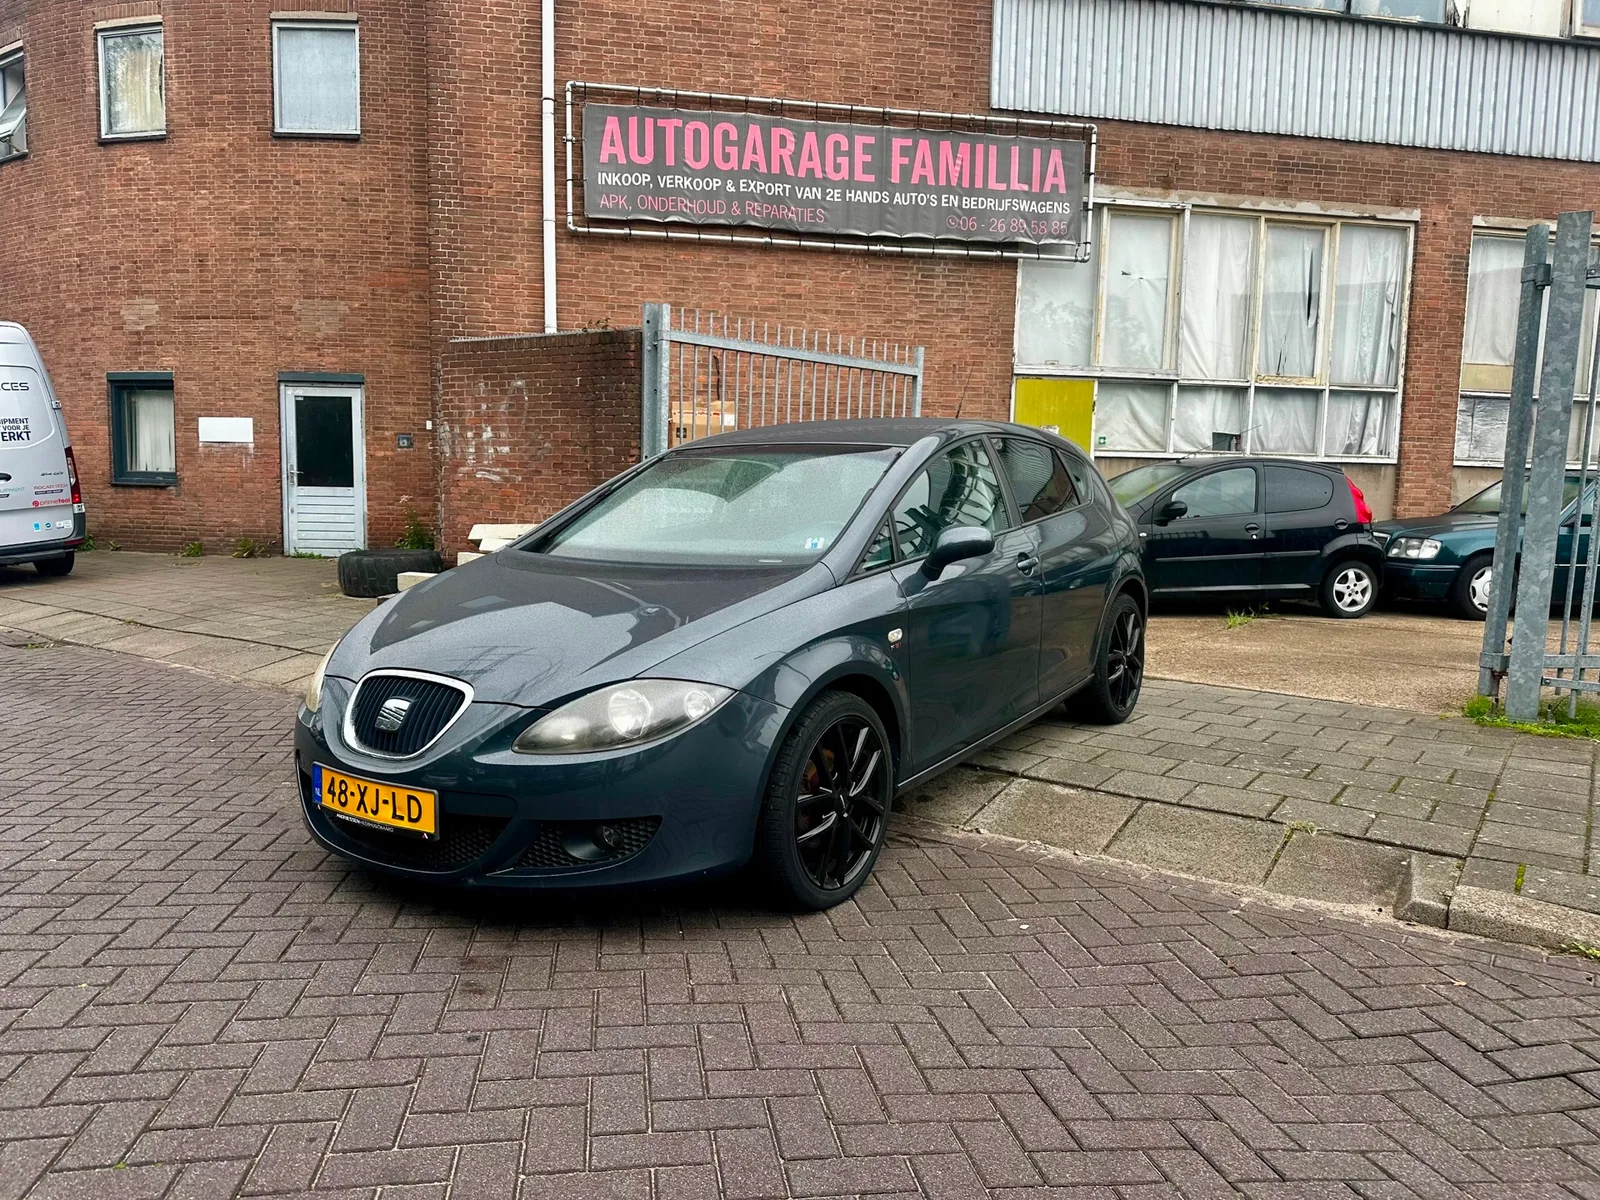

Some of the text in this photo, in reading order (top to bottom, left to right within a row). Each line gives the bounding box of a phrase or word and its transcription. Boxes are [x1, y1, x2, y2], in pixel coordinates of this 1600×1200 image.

[600, 116, 1066, 194] AUTOGARAGE FAMILLIA
[598, 172, 1070, 215] INKOOP, VERKOOP & EXPORT VAN 2E HANDS AUTO'S EN BEDRIJFSWAGENS
[600, 194, 825, 223] APK, ONDERHOUD & REPARATIES
[960, 216, 977, 231] 06
[989, 218, 1006, 233] 26
[1010, 219, 1027, 234] 89
[1031, 220, 1048, 234] 58
[1051, 220, 1068, 235] 85
[0, 382, 29, 391] CES
[327, 776, 422, 823] 48-XJ-LD
